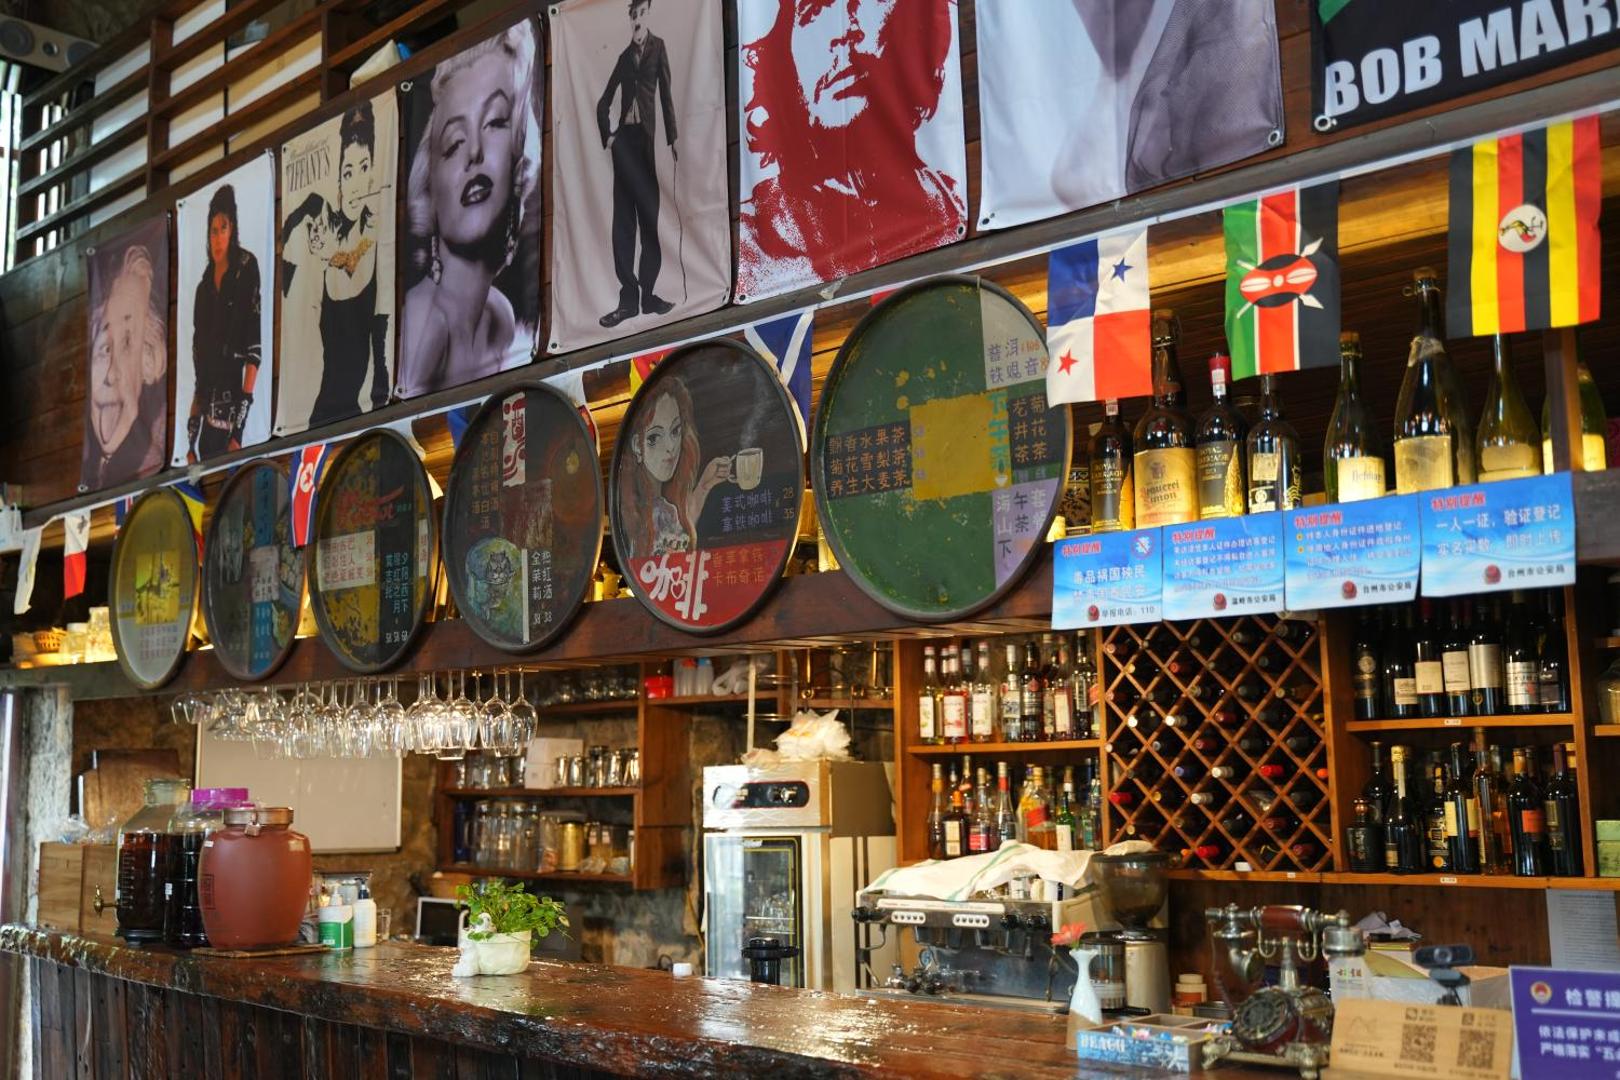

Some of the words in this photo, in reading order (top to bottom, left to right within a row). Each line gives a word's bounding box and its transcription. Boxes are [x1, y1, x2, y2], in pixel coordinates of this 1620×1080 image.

[1324, 35, 1443, 118] BOB
[1459, 0, 1620, 78] MAR
[1013, 399, 1030, 464] 龙井茶
[1031, 394, 1048, 460] 菊花茶
[1294, 510, 1344, 530] 特别提醒
[1431, 491, 1486, 511] 特别提醒
[1171, 526, 1217, 544] 特别提醒
